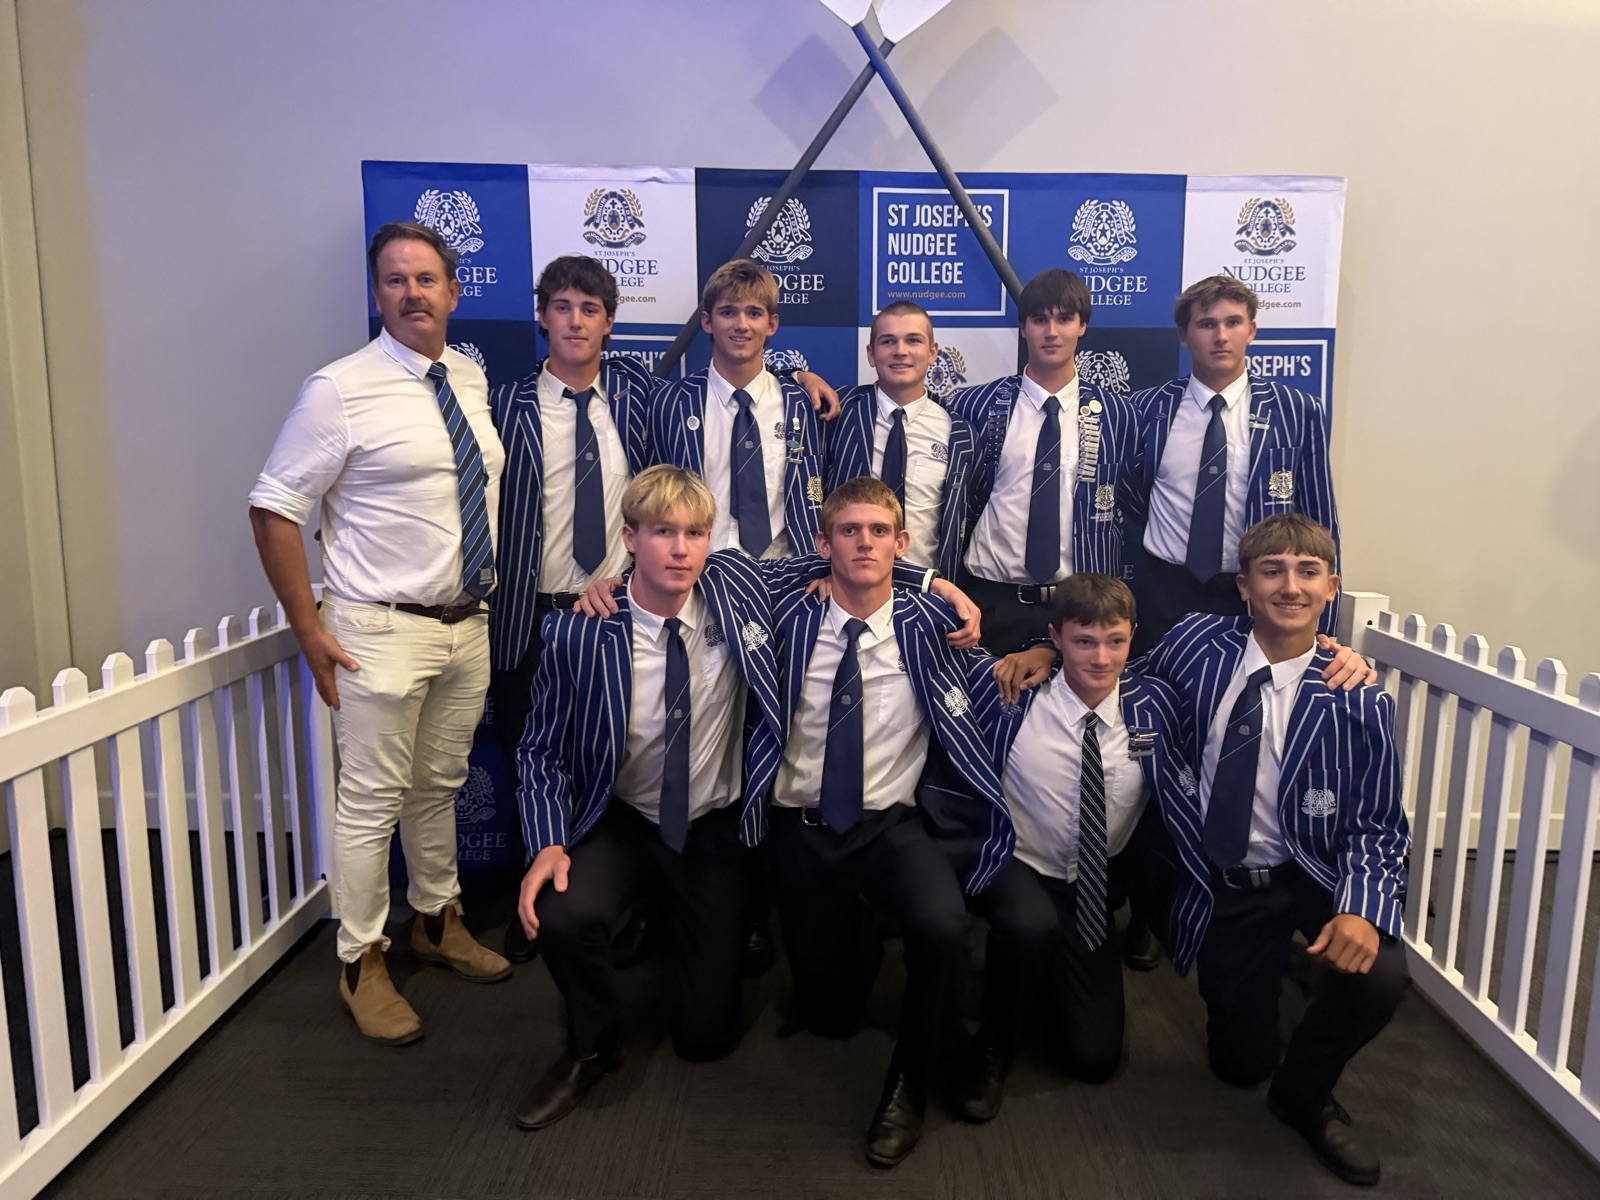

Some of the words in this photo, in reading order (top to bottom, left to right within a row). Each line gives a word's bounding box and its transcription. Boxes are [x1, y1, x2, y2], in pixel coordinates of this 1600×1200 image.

[887, 204, 909, 227] ST
[887, 233, 958, 256] NUDGEE
[604, 250, 636, 258] JOSEPH'S
[600, 258, 659, 276] DGEE
[887, 261, 964, 285] COLLEGE
[1222, 265, 1306, 281] NUDGEE
[456, 266, 498, 284] GEE
[1084, 275, 1148, 293] DGEE
[1247, 283, 1291, 293] OLLEGE
[619, 295, 657, 304] gee.com
[776, 293, 810, 305] LEGE
[887, 290, 966, 300] www.nudgee.com
[1090, 294, 1132, 306] LLEGE
[458, 850, 491, 861] LEGE
